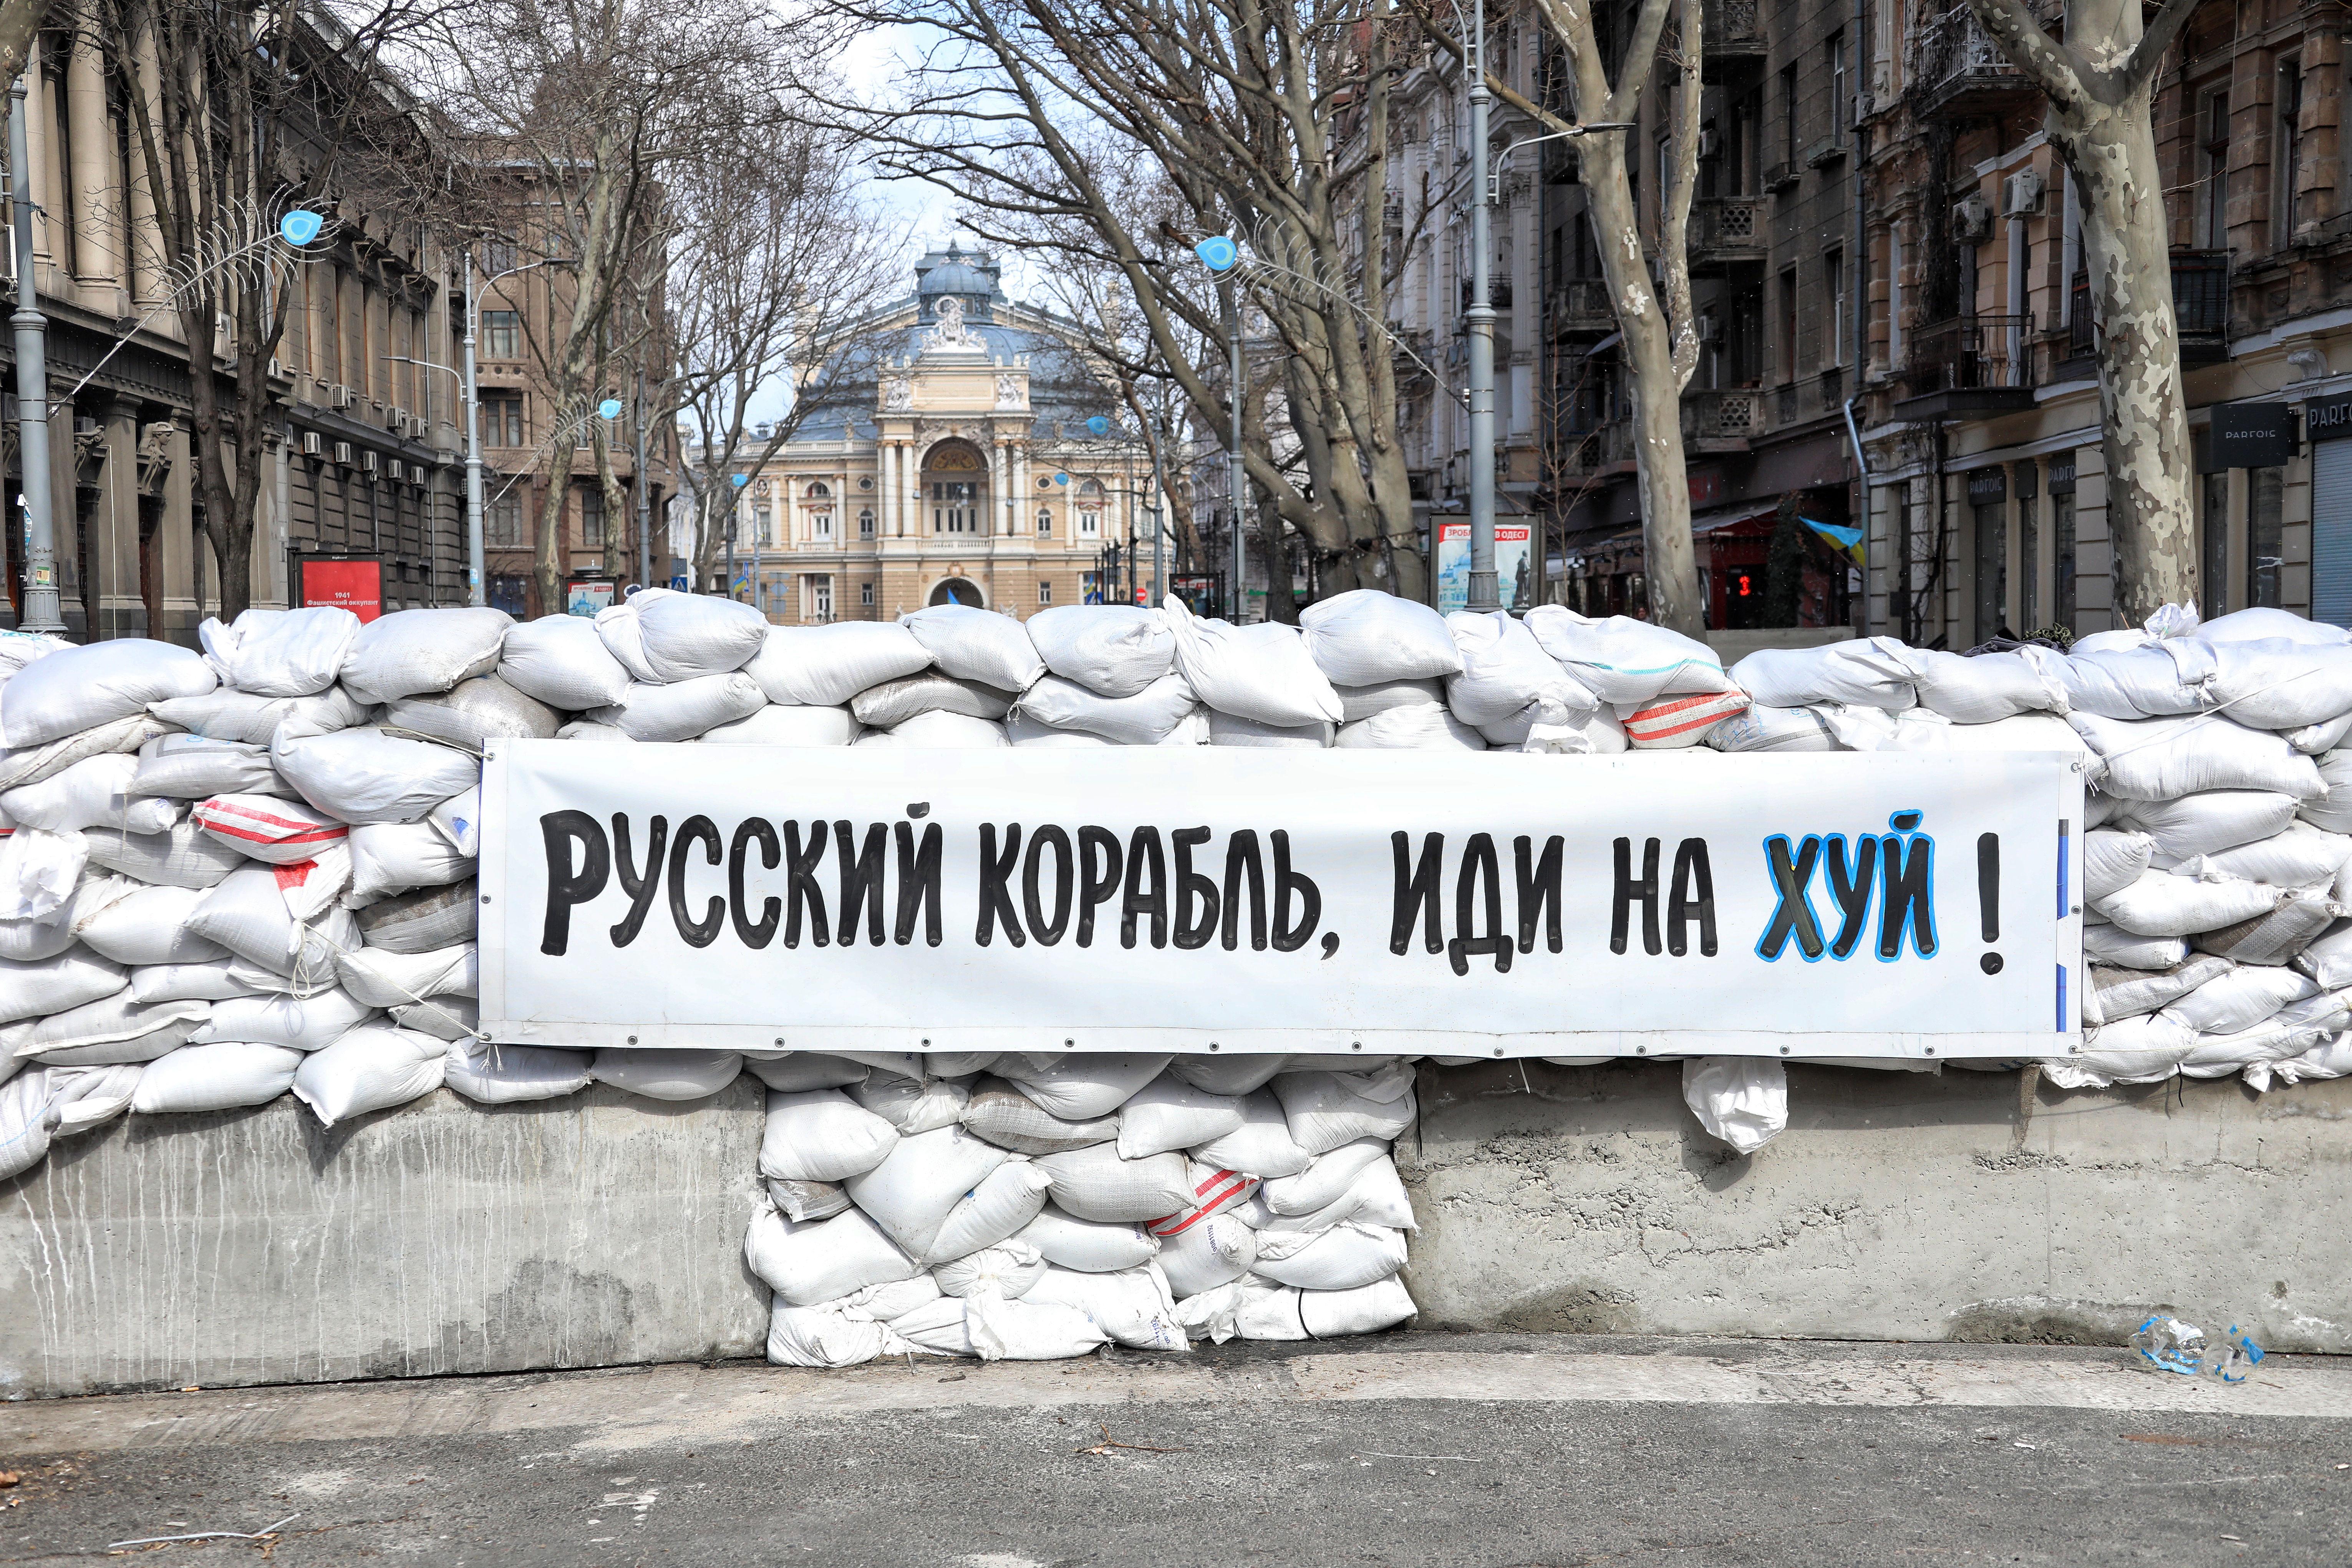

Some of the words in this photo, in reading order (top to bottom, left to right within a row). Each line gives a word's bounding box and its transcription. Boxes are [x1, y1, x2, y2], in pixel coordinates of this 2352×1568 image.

[2226, 430, 2276, 439] PARFOIS
[2048, 465, 2075, 484] PARFO
[1969, 477, 2003, 494] PARFOIS
[1501, 531, 1525, 539] ОДЕСІ
[540, 802, 942, 956] РУССКИЙ
[976, 823, 1339, 957] КОРАБЛЬ,
[1390, 831, 1564, 976] ИДИ
[1610, 832, 1717, 957] НА
[1754, 809, 1939, 963] ХУЙ
[1977, 832, 2004, 976] !
[1207, 1224, 1217, 1252] 90811192
